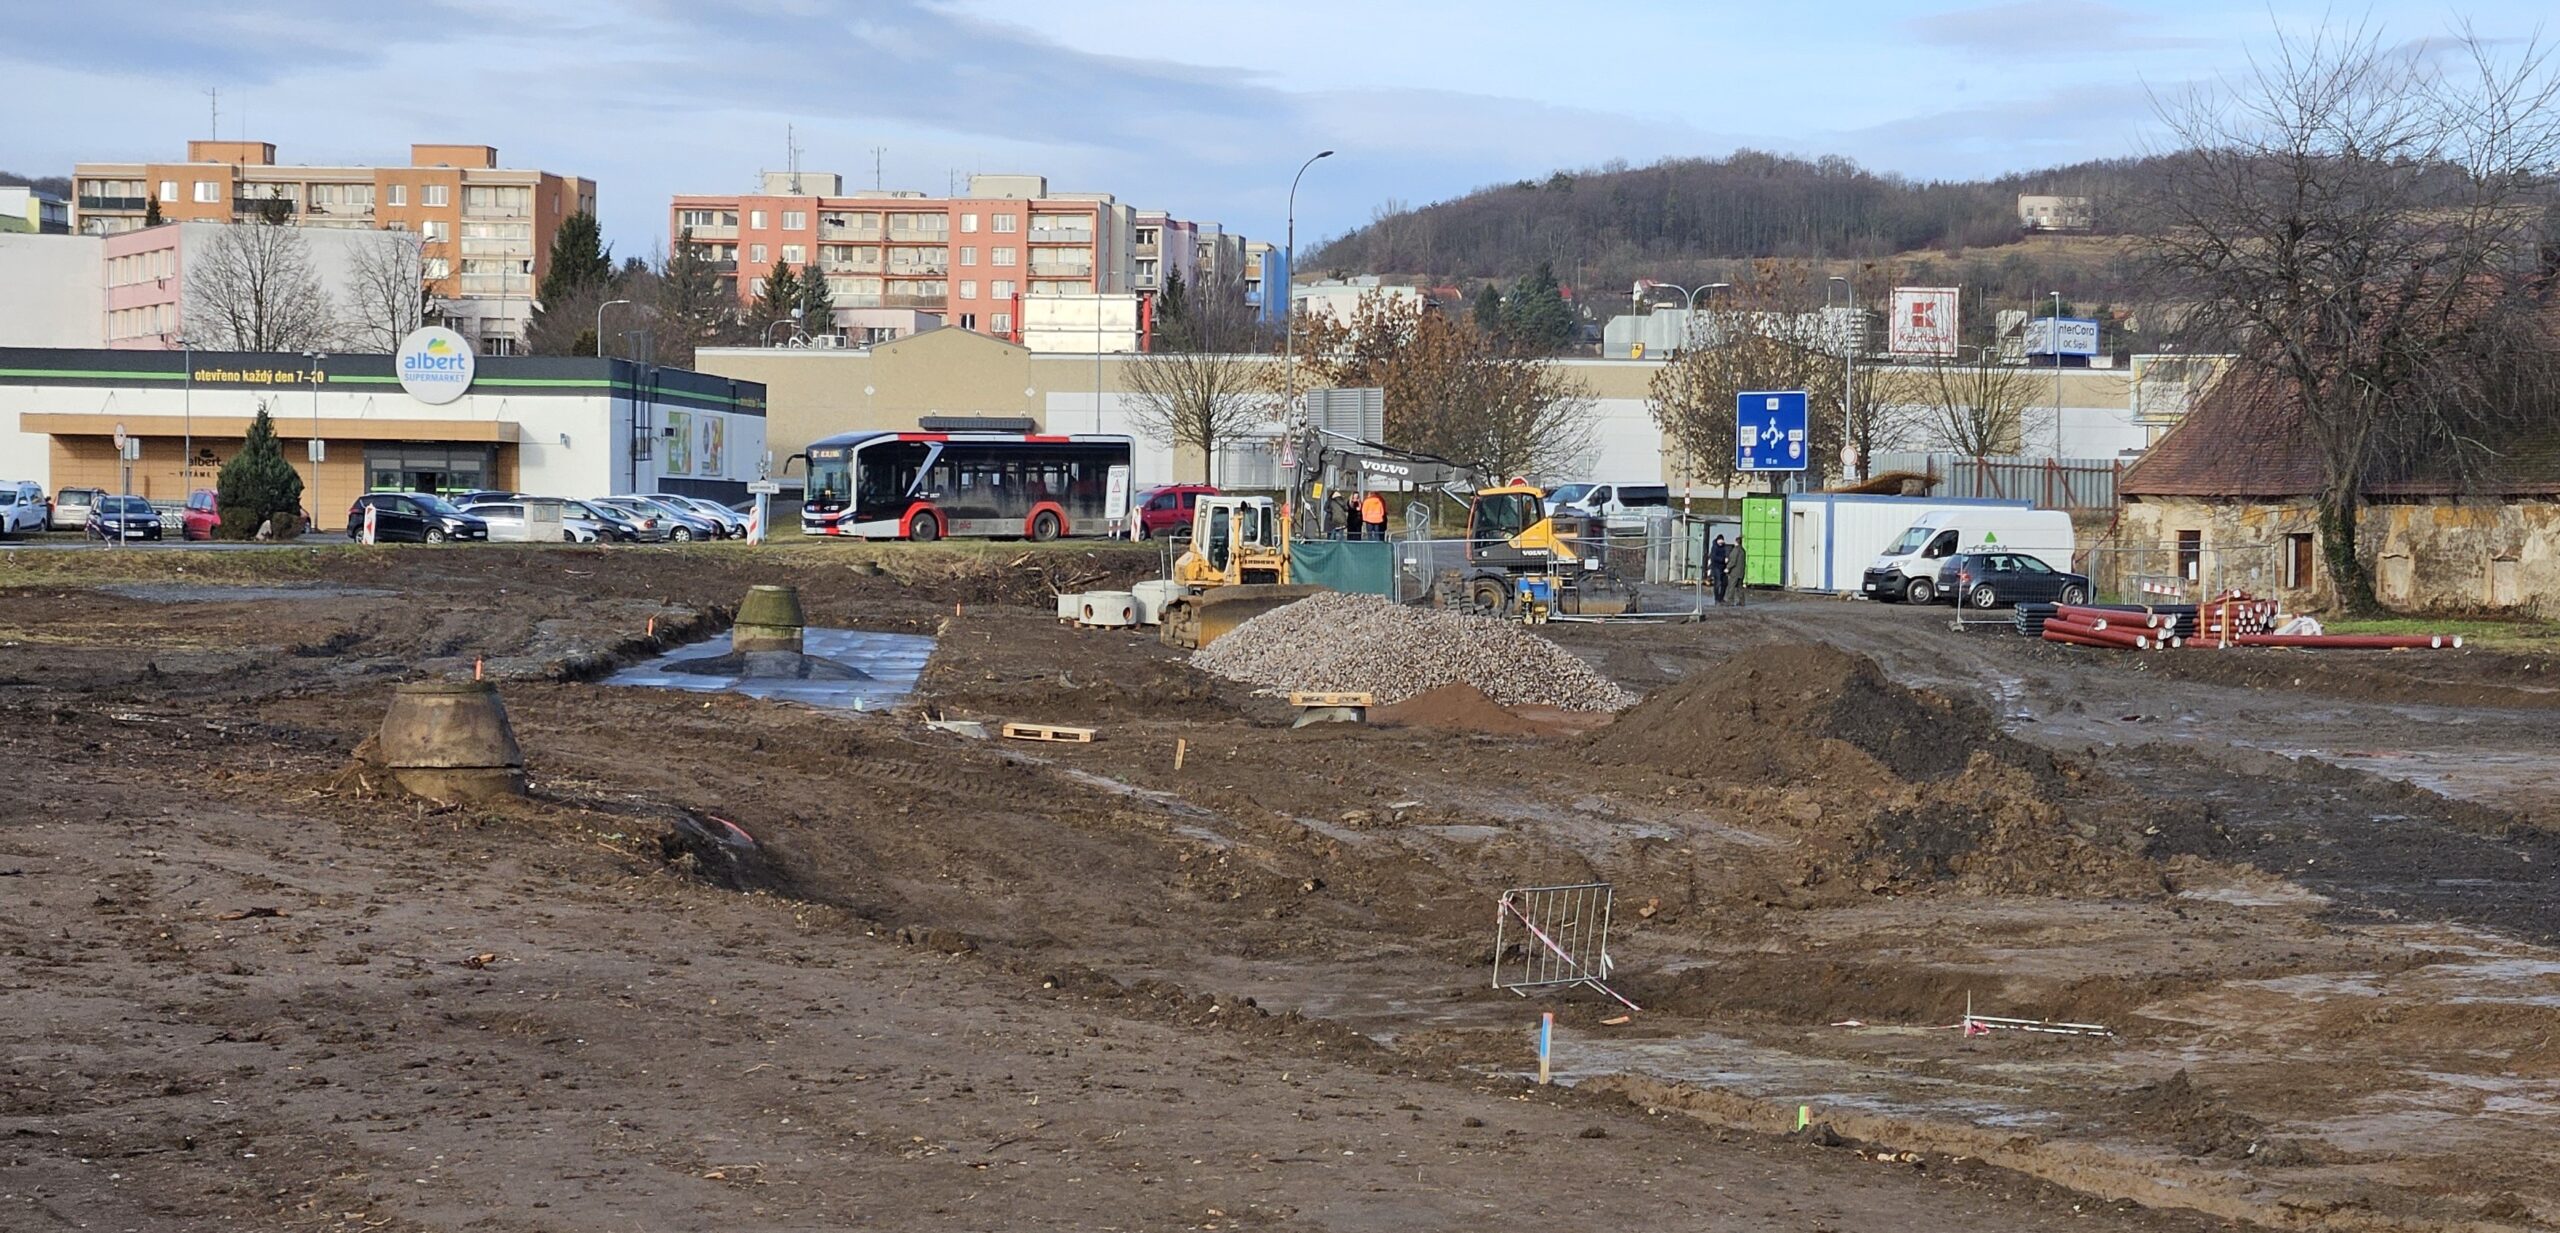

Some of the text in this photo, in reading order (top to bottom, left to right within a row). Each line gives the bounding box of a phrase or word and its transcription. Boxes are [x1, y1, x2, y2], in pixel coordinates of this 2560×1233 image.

[2056, 323, 2094, 336] nterCora
[2063, 339, 2073, 348] OC
[404, 352, 465, 369] albert
[195, 369, 240, 381] otevřeno
[242, 369, 272, 384] každý
[275, 370, 294, 382] den
[404, 373, 465, 382] SUPERMARKET
[188, 456, 223, 466] albert
[1360, 460, 1409, 475] VOLVO
